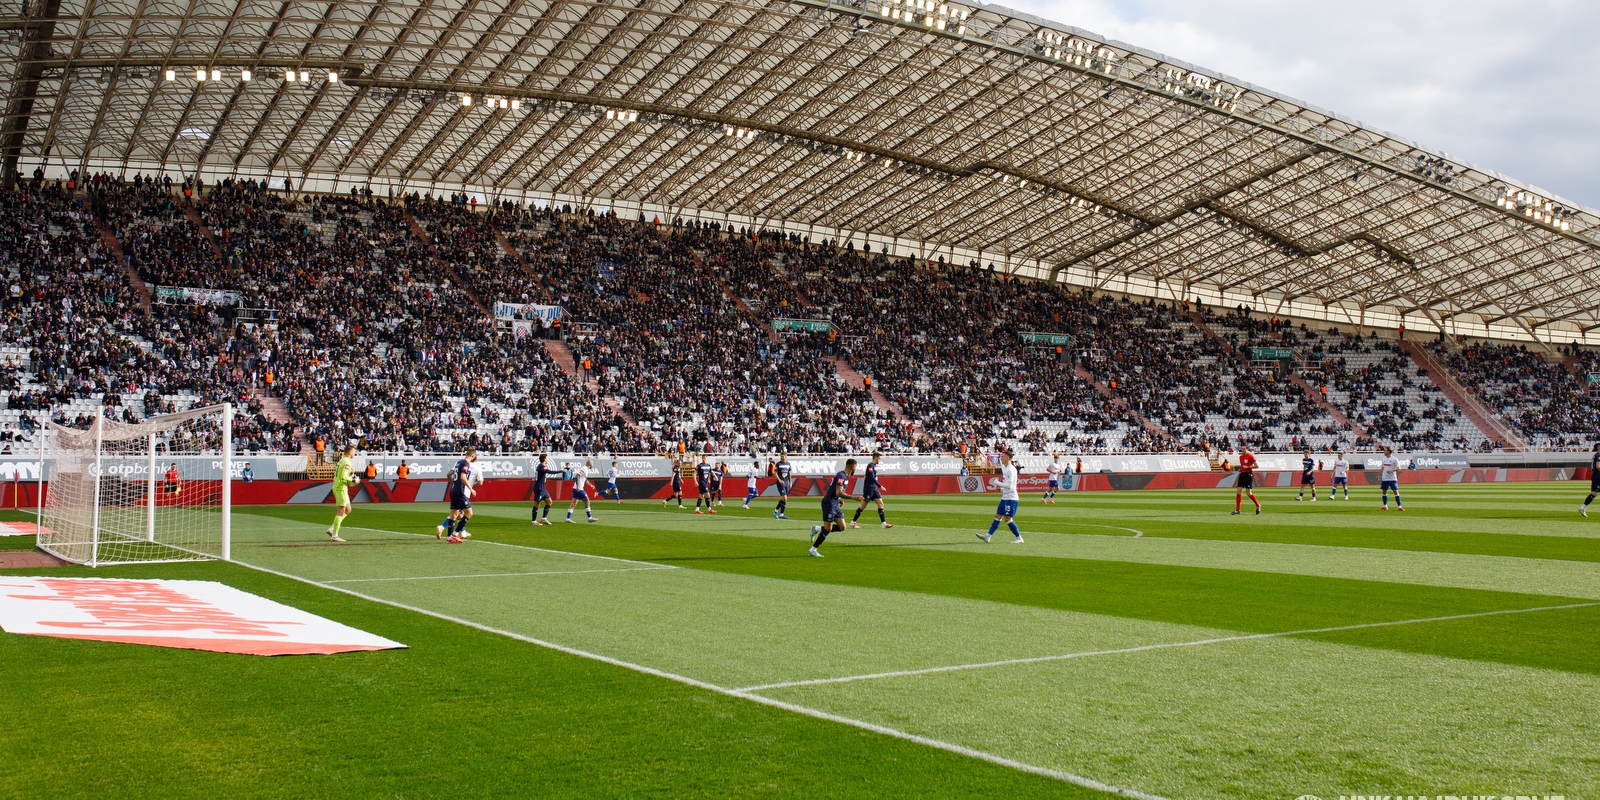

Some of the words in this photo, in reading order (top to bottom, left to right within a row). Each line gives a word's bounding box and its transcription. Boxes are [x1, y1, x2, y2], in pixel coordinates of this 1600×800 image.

[921, 461, 961, 471] otpbanka
[1173, 460, 1206, 469] LUKOIL
[1417, 458, 1440, 466] OlyBet
[790, 461, 837, 473] TOMMY
